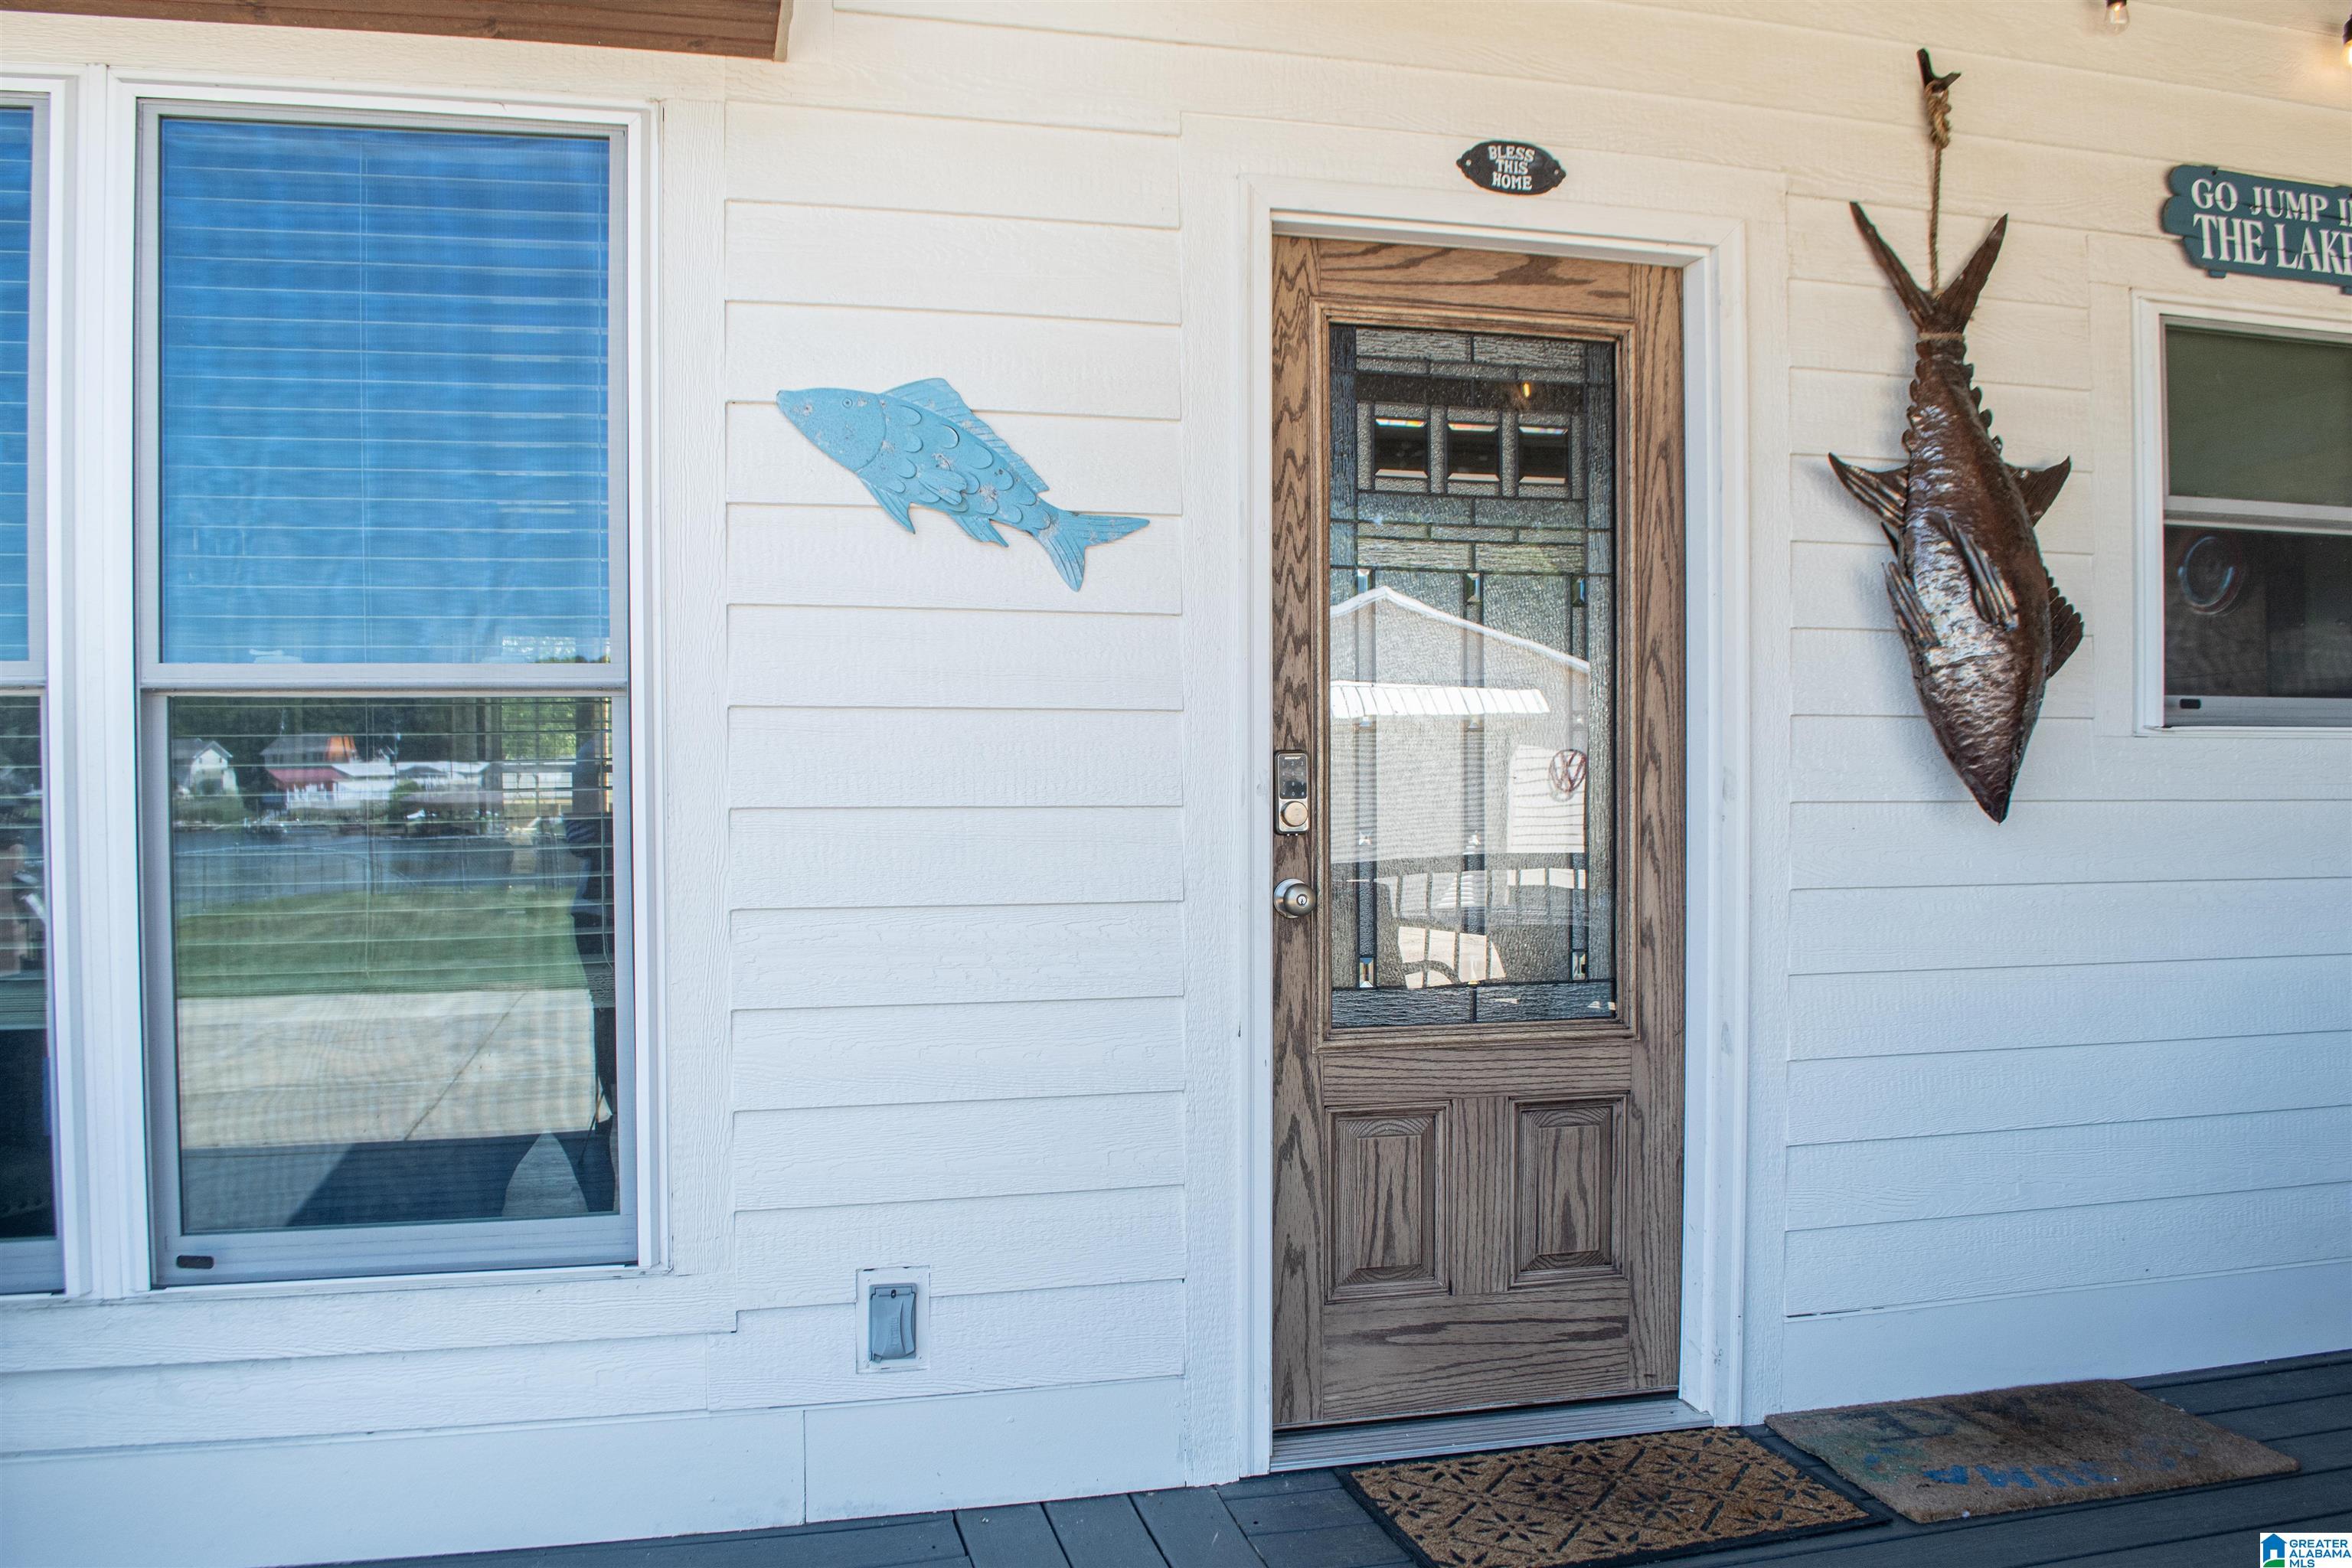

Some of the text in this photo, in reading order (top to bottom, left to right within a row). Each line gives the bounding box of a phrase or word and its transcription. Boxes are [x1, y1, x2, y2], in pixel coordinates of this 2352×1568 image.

[1488, 145, 1535, 163] BLESS
[1495, 159, 1528, 175] THIS
[1491, 172, 1533, 191] HOME
[2190, 178, 2352, 227] GO JUMP I
[2193, 213, 2267, 266] THE
